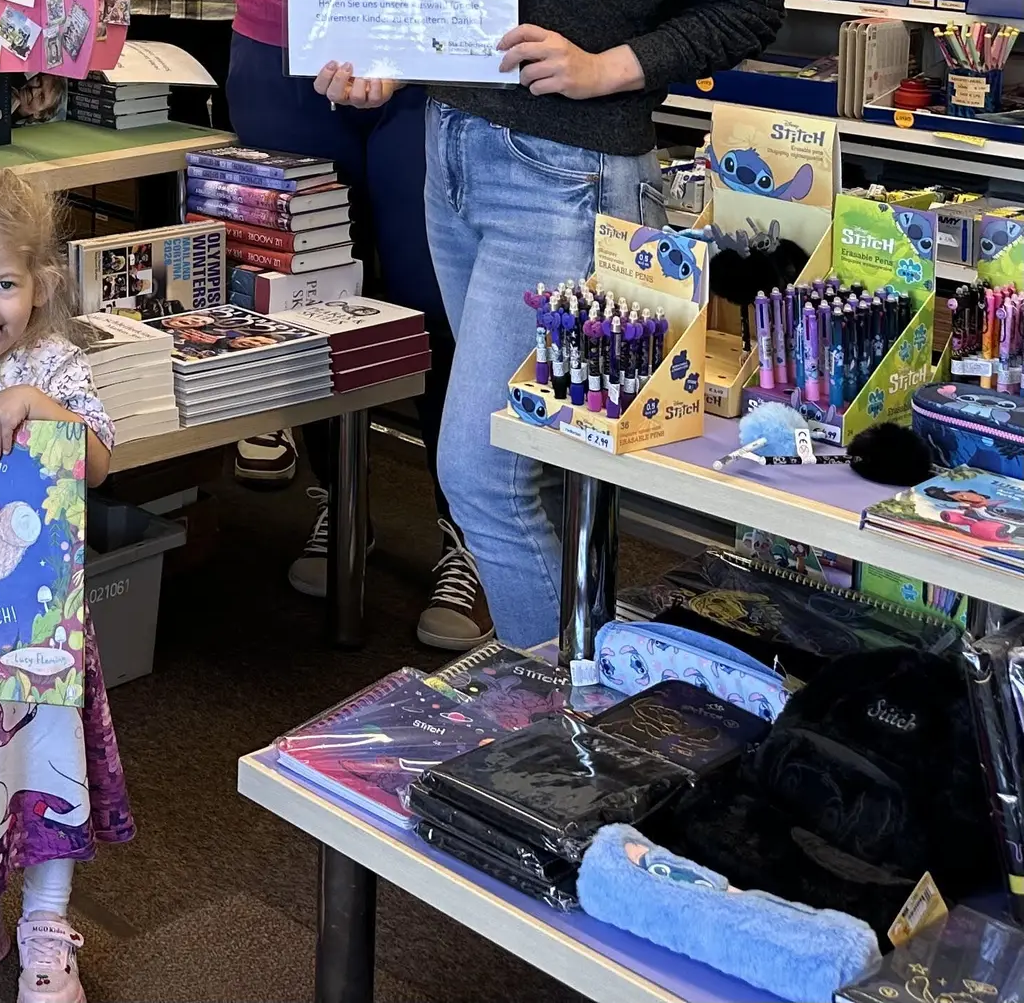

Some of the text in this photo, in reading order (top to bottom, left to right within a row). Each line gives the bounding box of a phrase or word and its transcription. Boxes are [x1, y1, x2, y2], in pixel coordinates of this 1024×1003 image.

[347, 0, 360, 8] Sie
[937, 216, 960, 225] AMY
[247, 231, 274, 246] MOORE
[172, 238, 182, 281] CORTINA
[182, 236, 191, 281] MAILAND
[247, 252, 272, 265] MOORE
[840, 247, 898, 266] Erasable Pens
[192, 234, 206, 309] WINTERS
[207, 232, 221, 308] OLYMPIS
[598, 260, 654, 283] ERASABLE PENS
[620, 422, 629, 430] 36
[619, 433, 649, 447] ERASABLE
[89, 578, 130, 604] 021061
[512, 665, 568, 686] STITCH
[866, 698, 917, 732] Stitch
[412, 719, 447, 736] STITCH
